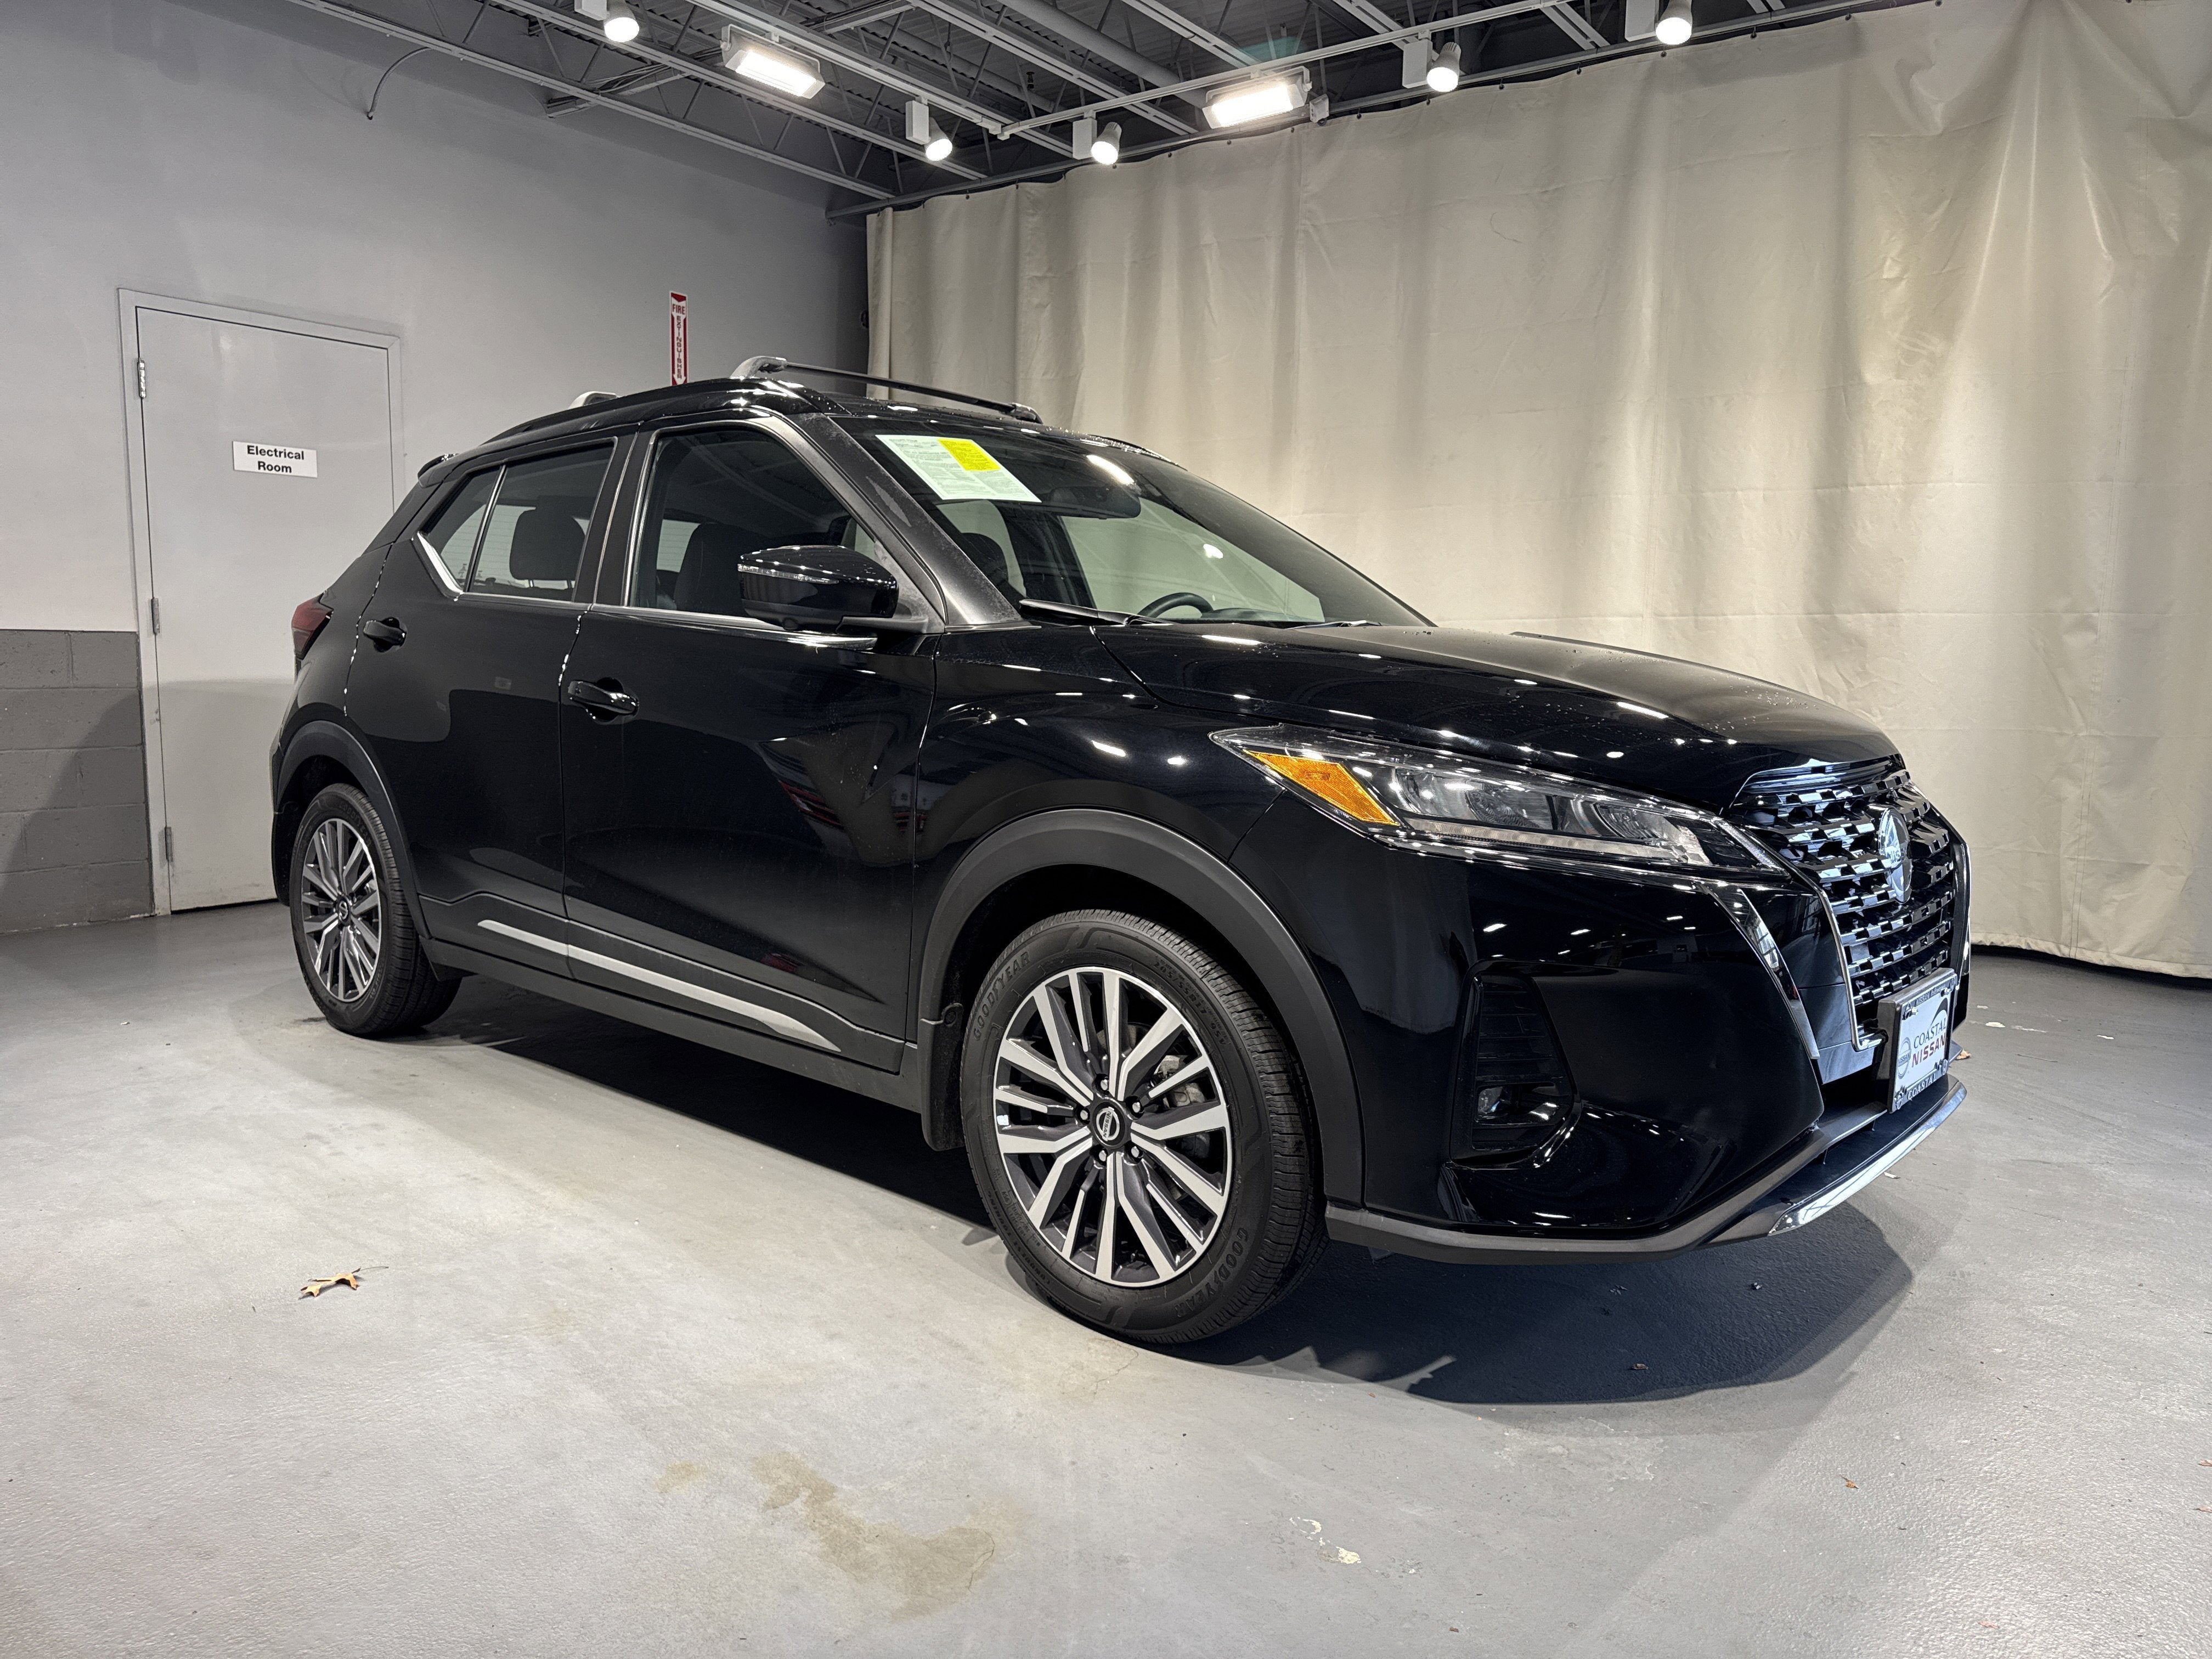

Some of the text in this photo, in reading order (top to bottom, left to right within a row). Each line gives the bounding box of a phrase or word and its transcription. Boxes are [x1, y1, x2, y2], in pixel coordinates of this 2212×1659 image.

[672, 304, 685, 315] FIRE
[247, 445, 304, 460] Electrical
[257, 461, 292, 473] Room
[973, 951, 1031, 1041] GOODYEAR
[1153, 961, 1207, 1014] 205/55R17
[1914, 1017, 1946, 1048] COASTAL
[1912, 1032, 1946, 1068] NISSAN
[1908, 1073, 1937, 1101] COASTAL
[1103, 1110, 1111, 1138] NISSAN
[1175, 1227, 1249, 1317] GOODYEAR
